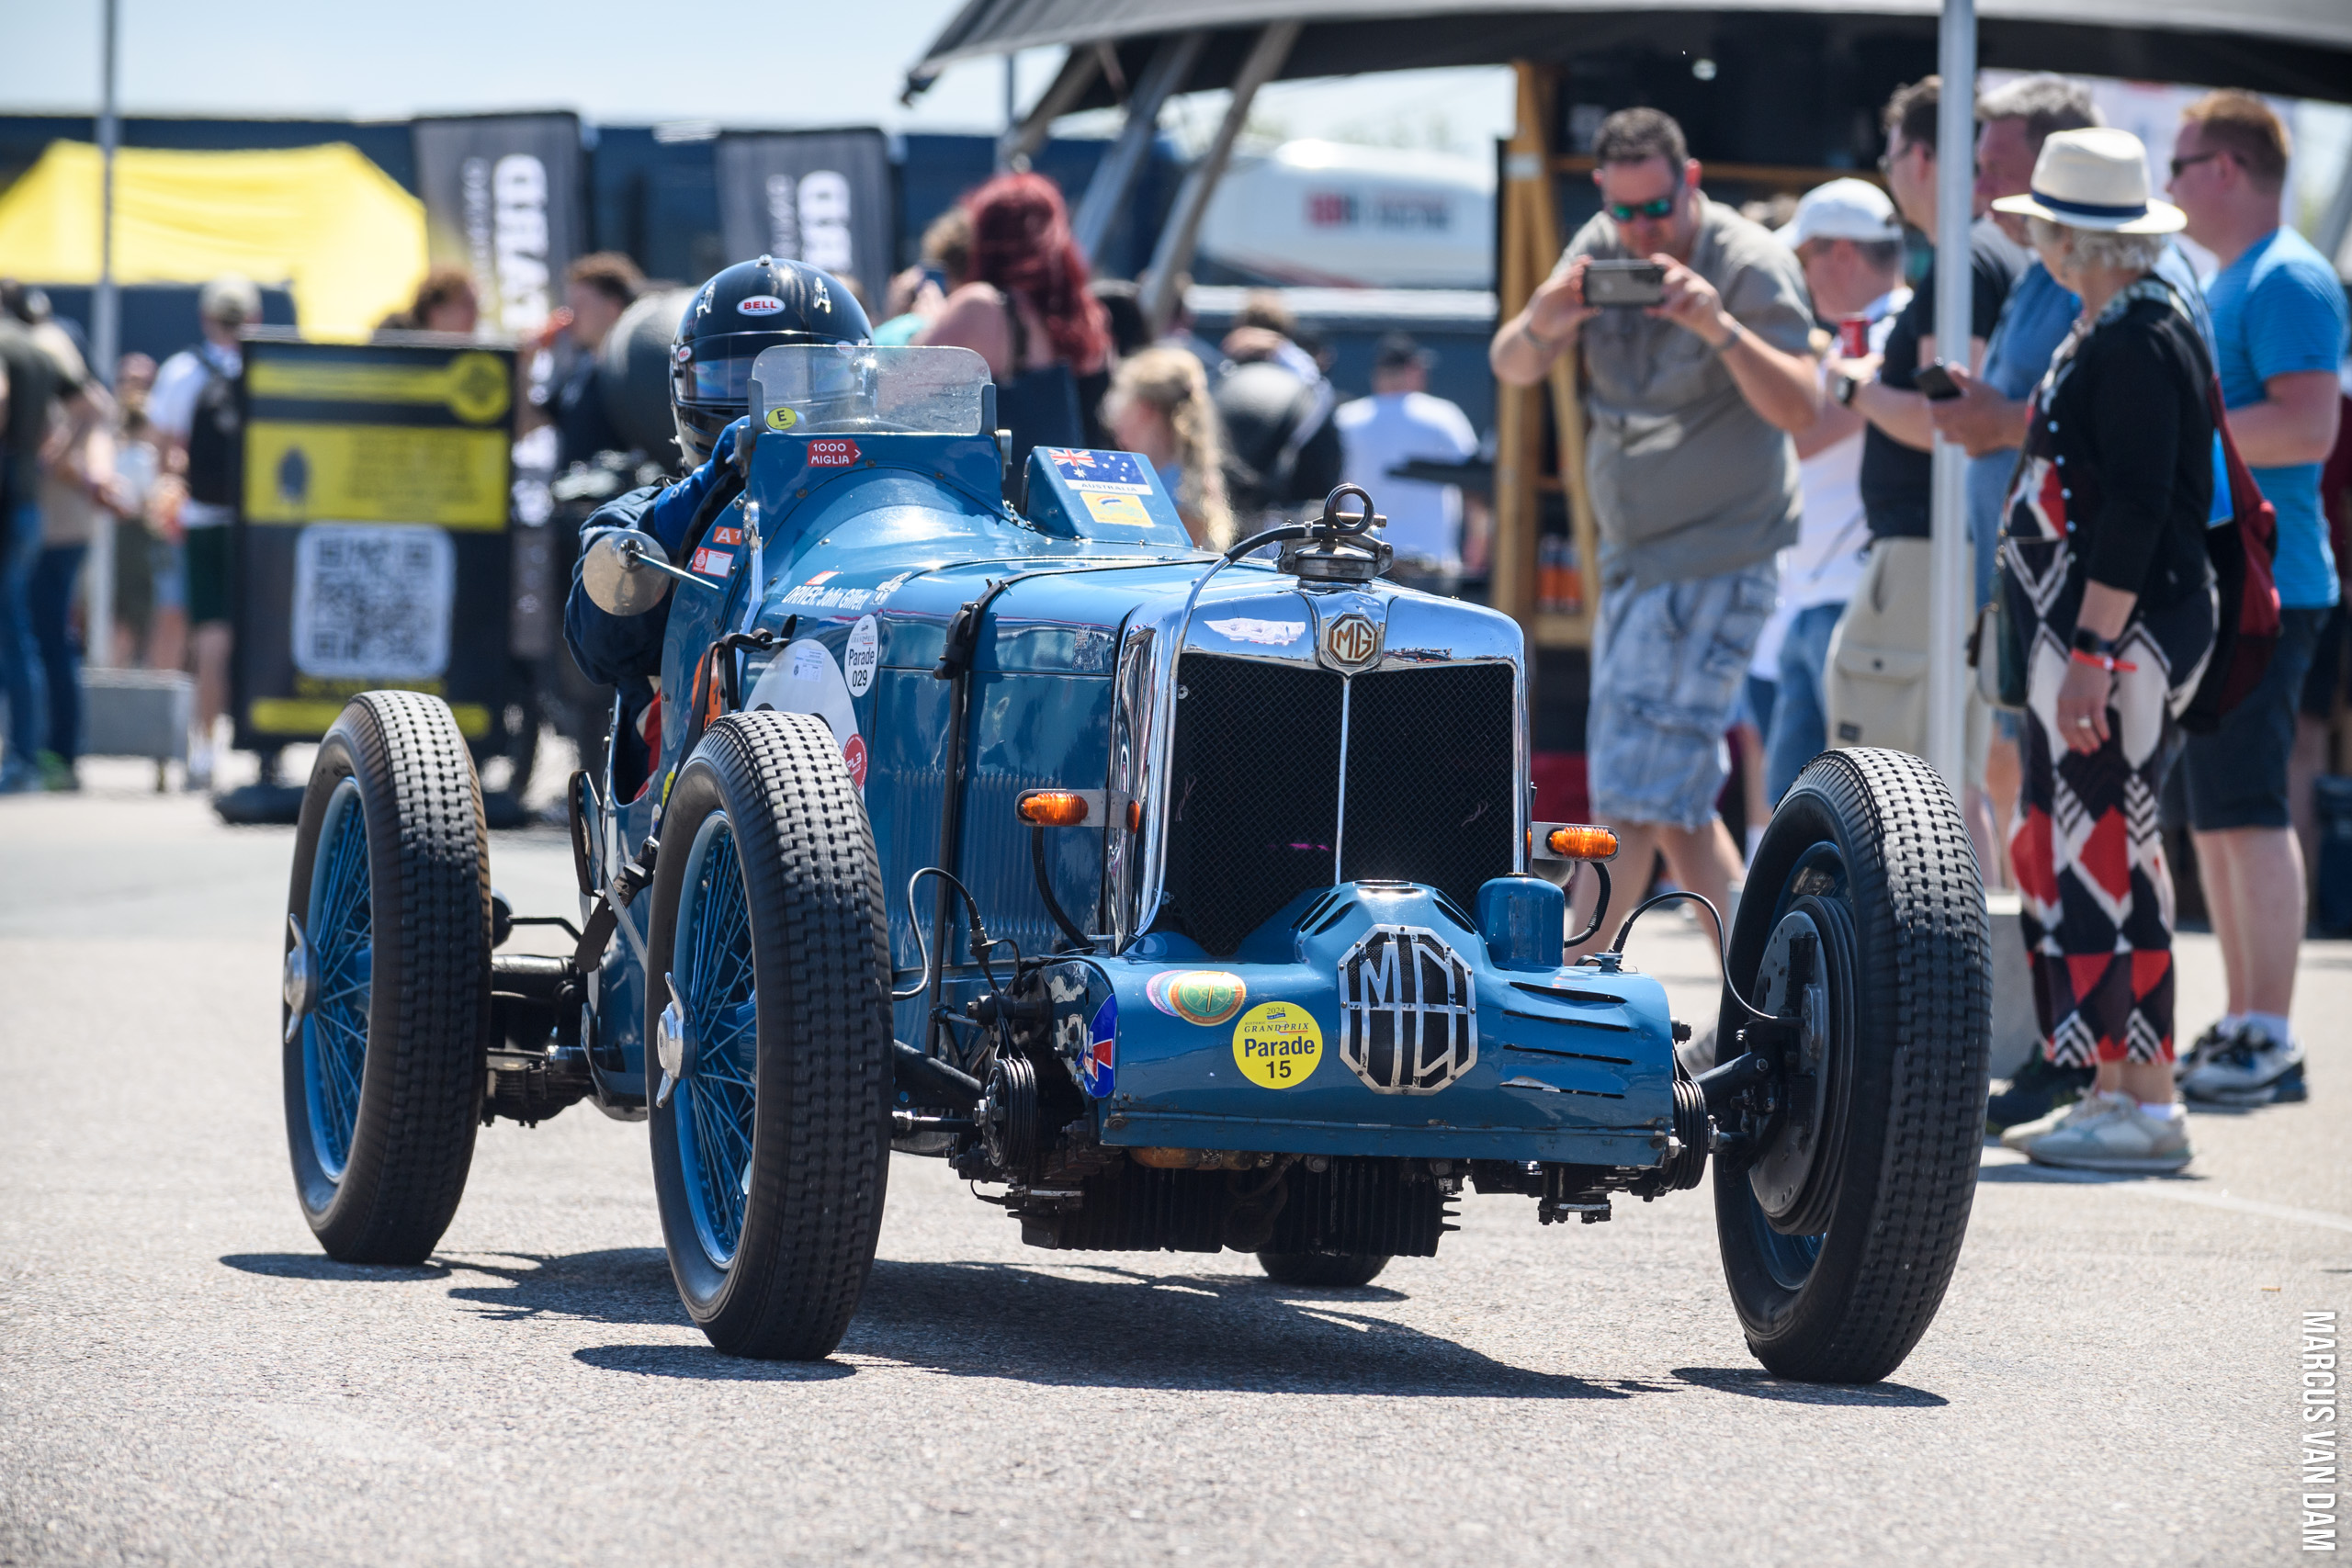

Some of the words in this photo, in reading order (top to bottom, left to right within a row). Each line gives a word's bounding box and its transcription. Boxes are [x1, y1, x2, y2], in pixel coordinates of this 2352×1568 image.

[743, 301, 777, 310] BELL
[776, 410, 787, 422] E
[813, 443, 847, 452] 1000
[810, 455, 850, 464] MIGLIA
[1081, 482, 1137, 491] AUSTRALIA
[816, 587, 842, 607] John
[1336, 621, 1373, 659] MG
[848, 647, 875, 666] Parade
[852, 670, 867, 687] 029
[1266, 1007, 1285, 1015] 2024
[1358, 937, 1458, 1089] MG
[1244, 1024, 1282, 1033] GRAND
[1283, 1022, 1309, 1031] PRIX
[1245, 1036, 1315, 1057] Parade
[1266, 1060, 1292, 1079] 15
